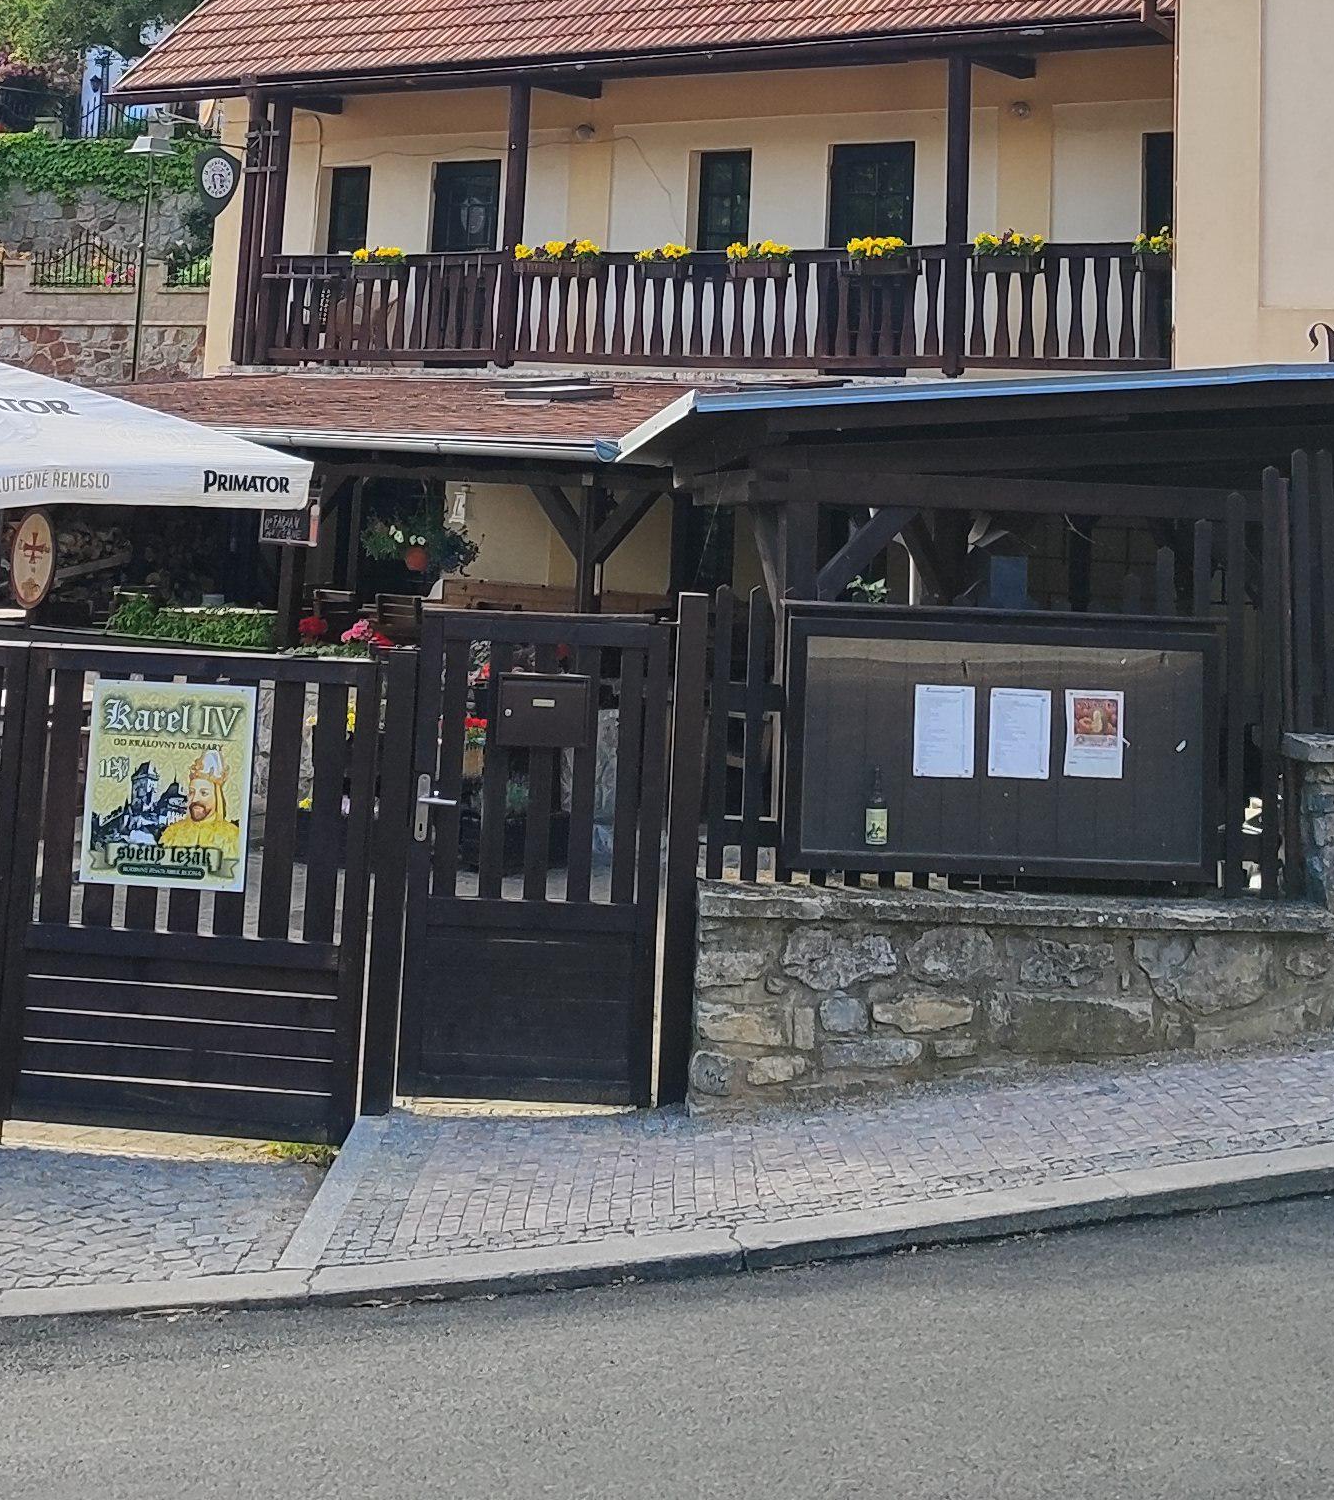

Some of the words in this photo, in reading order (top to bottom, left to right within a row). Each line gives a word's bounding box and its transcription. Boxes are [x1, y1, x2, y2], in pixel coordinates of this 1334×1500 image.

[52, 470, 110, 490] ŘEMESLO
[203, 469, 290, 494] PRIMATOR
[104, 698, 192, 735] Karel
[199, 704, 242, 738] IV
[113, 737, 127, 747] OD
[128, 737, 177, 750] KRÁLOVNY
[178, 742, 224, 752] DAGMARY
